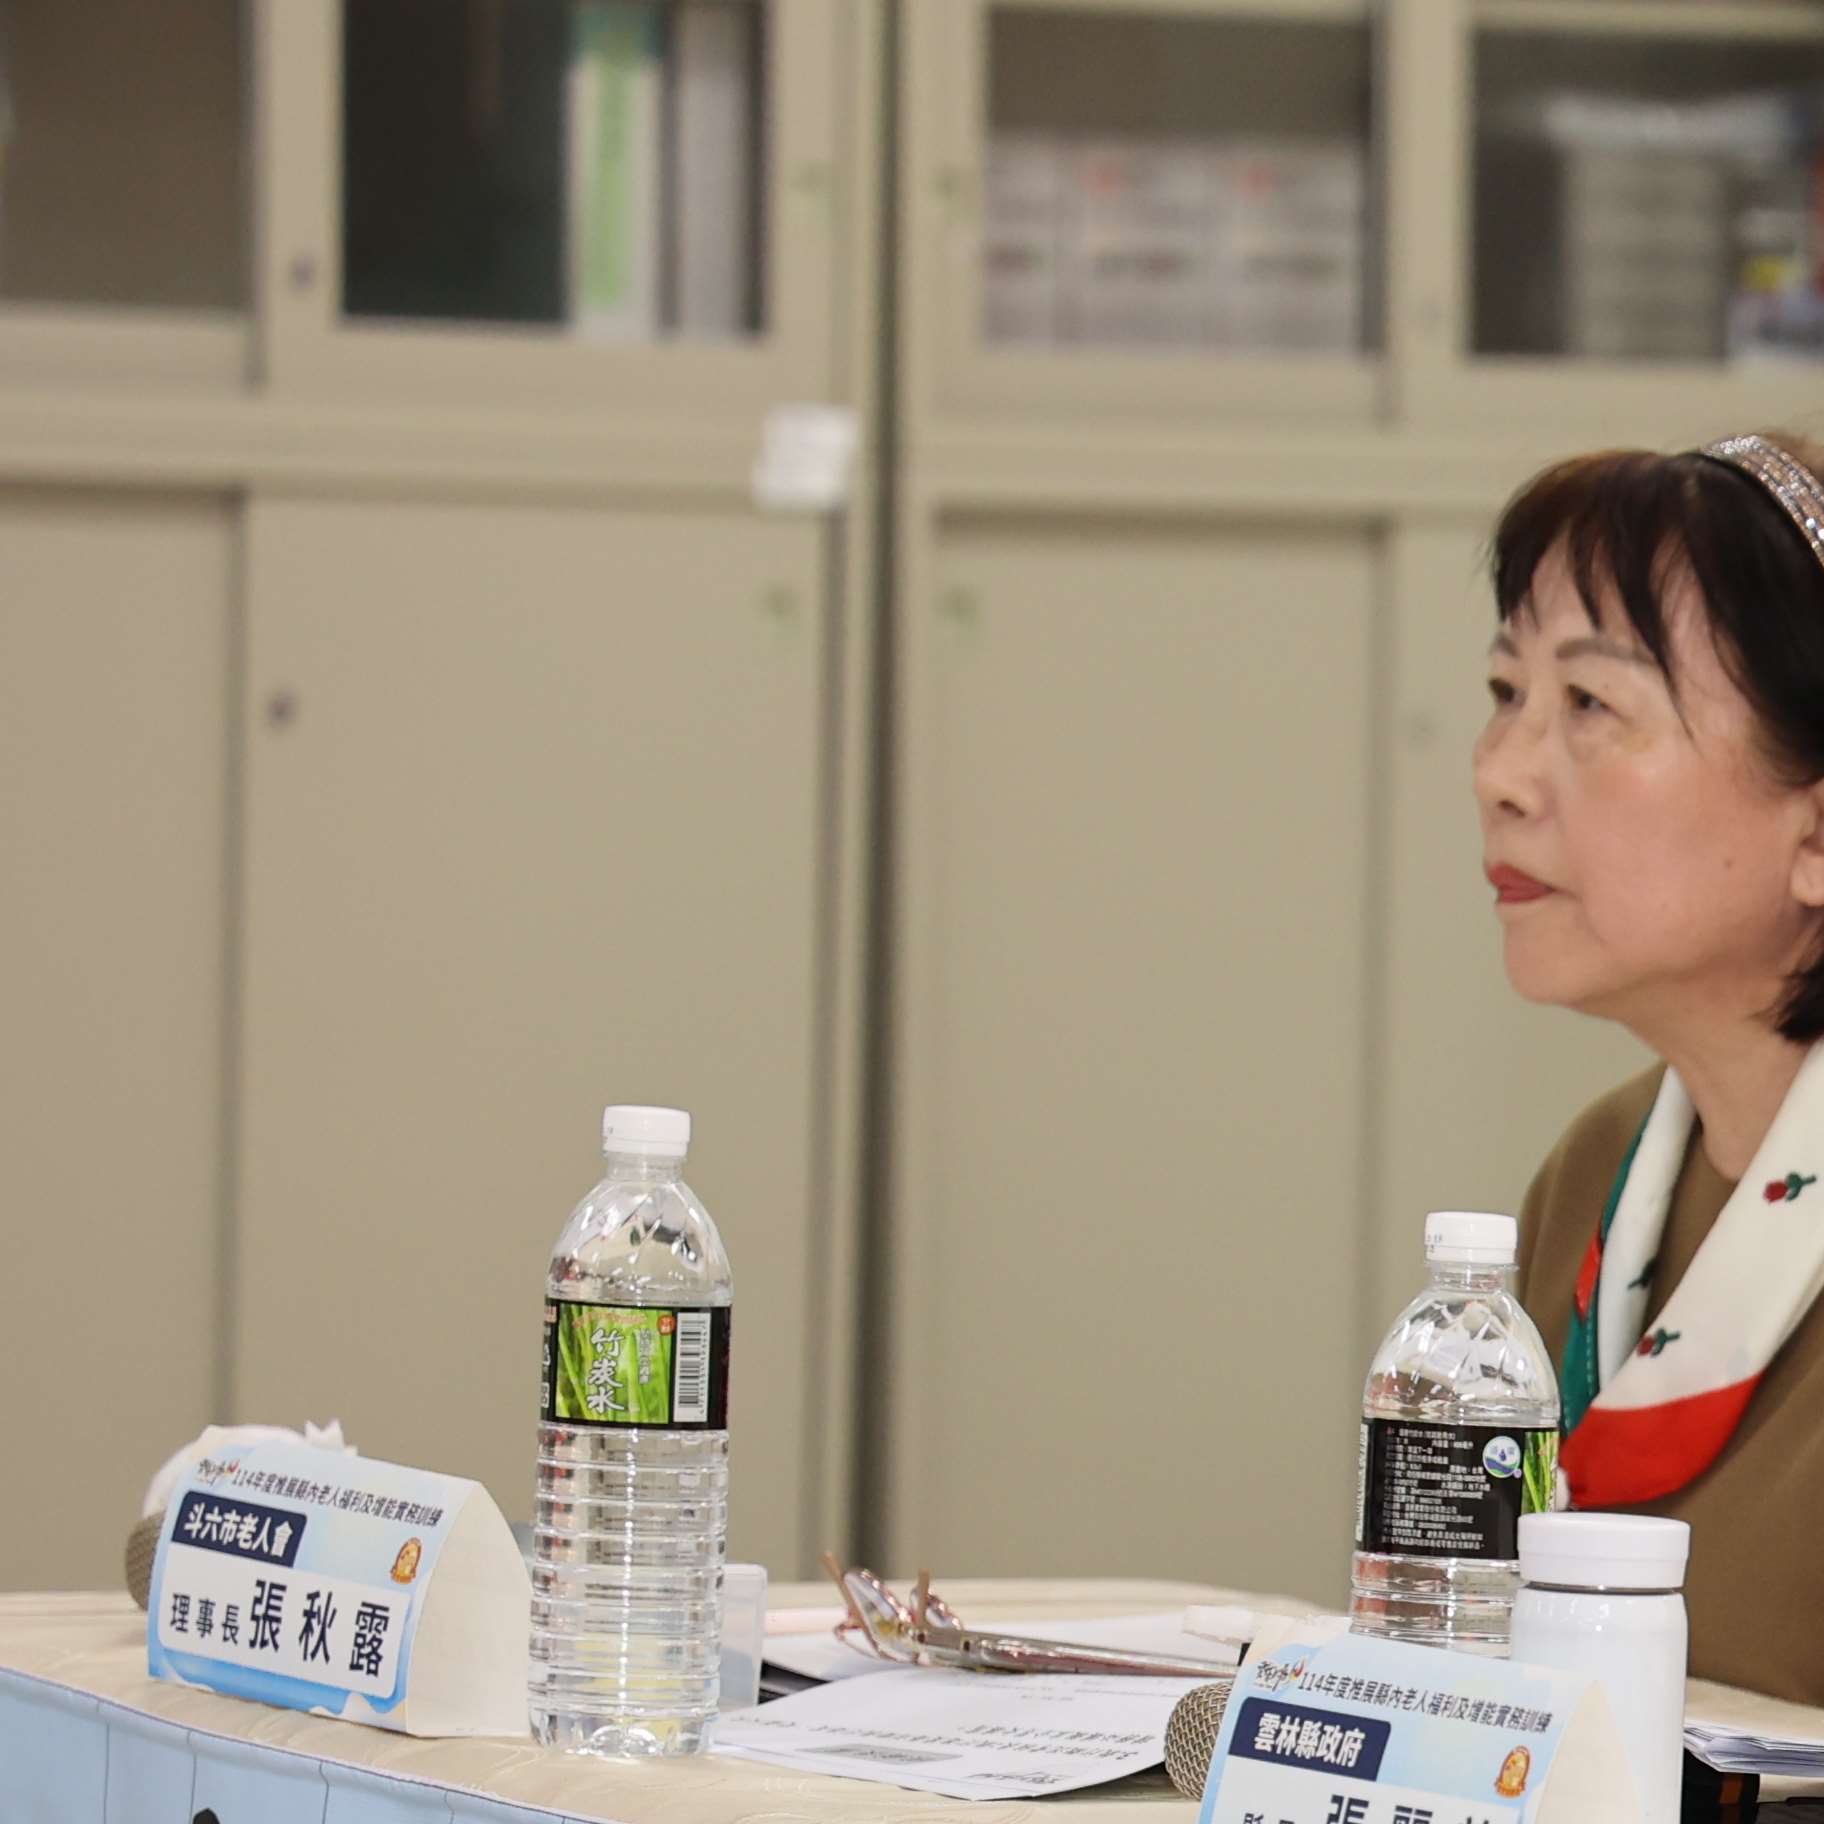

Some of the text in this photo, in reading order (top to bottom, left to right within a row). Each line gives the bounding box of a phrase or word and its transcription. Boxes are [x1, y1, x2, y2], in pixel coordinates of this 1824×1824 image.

[587, 1328, 626, 1415] 竹炭水
[184, 1502, 293, 1558] 斗六市老人會
[170, 1579, 391, 1678] 理事長 張秋露
[1297, 1671, 1553, 1735] 114年度推展縣內老人福利及增能實務訓練
[1253, 1712, 1366, 1769] 雲林縣政府
